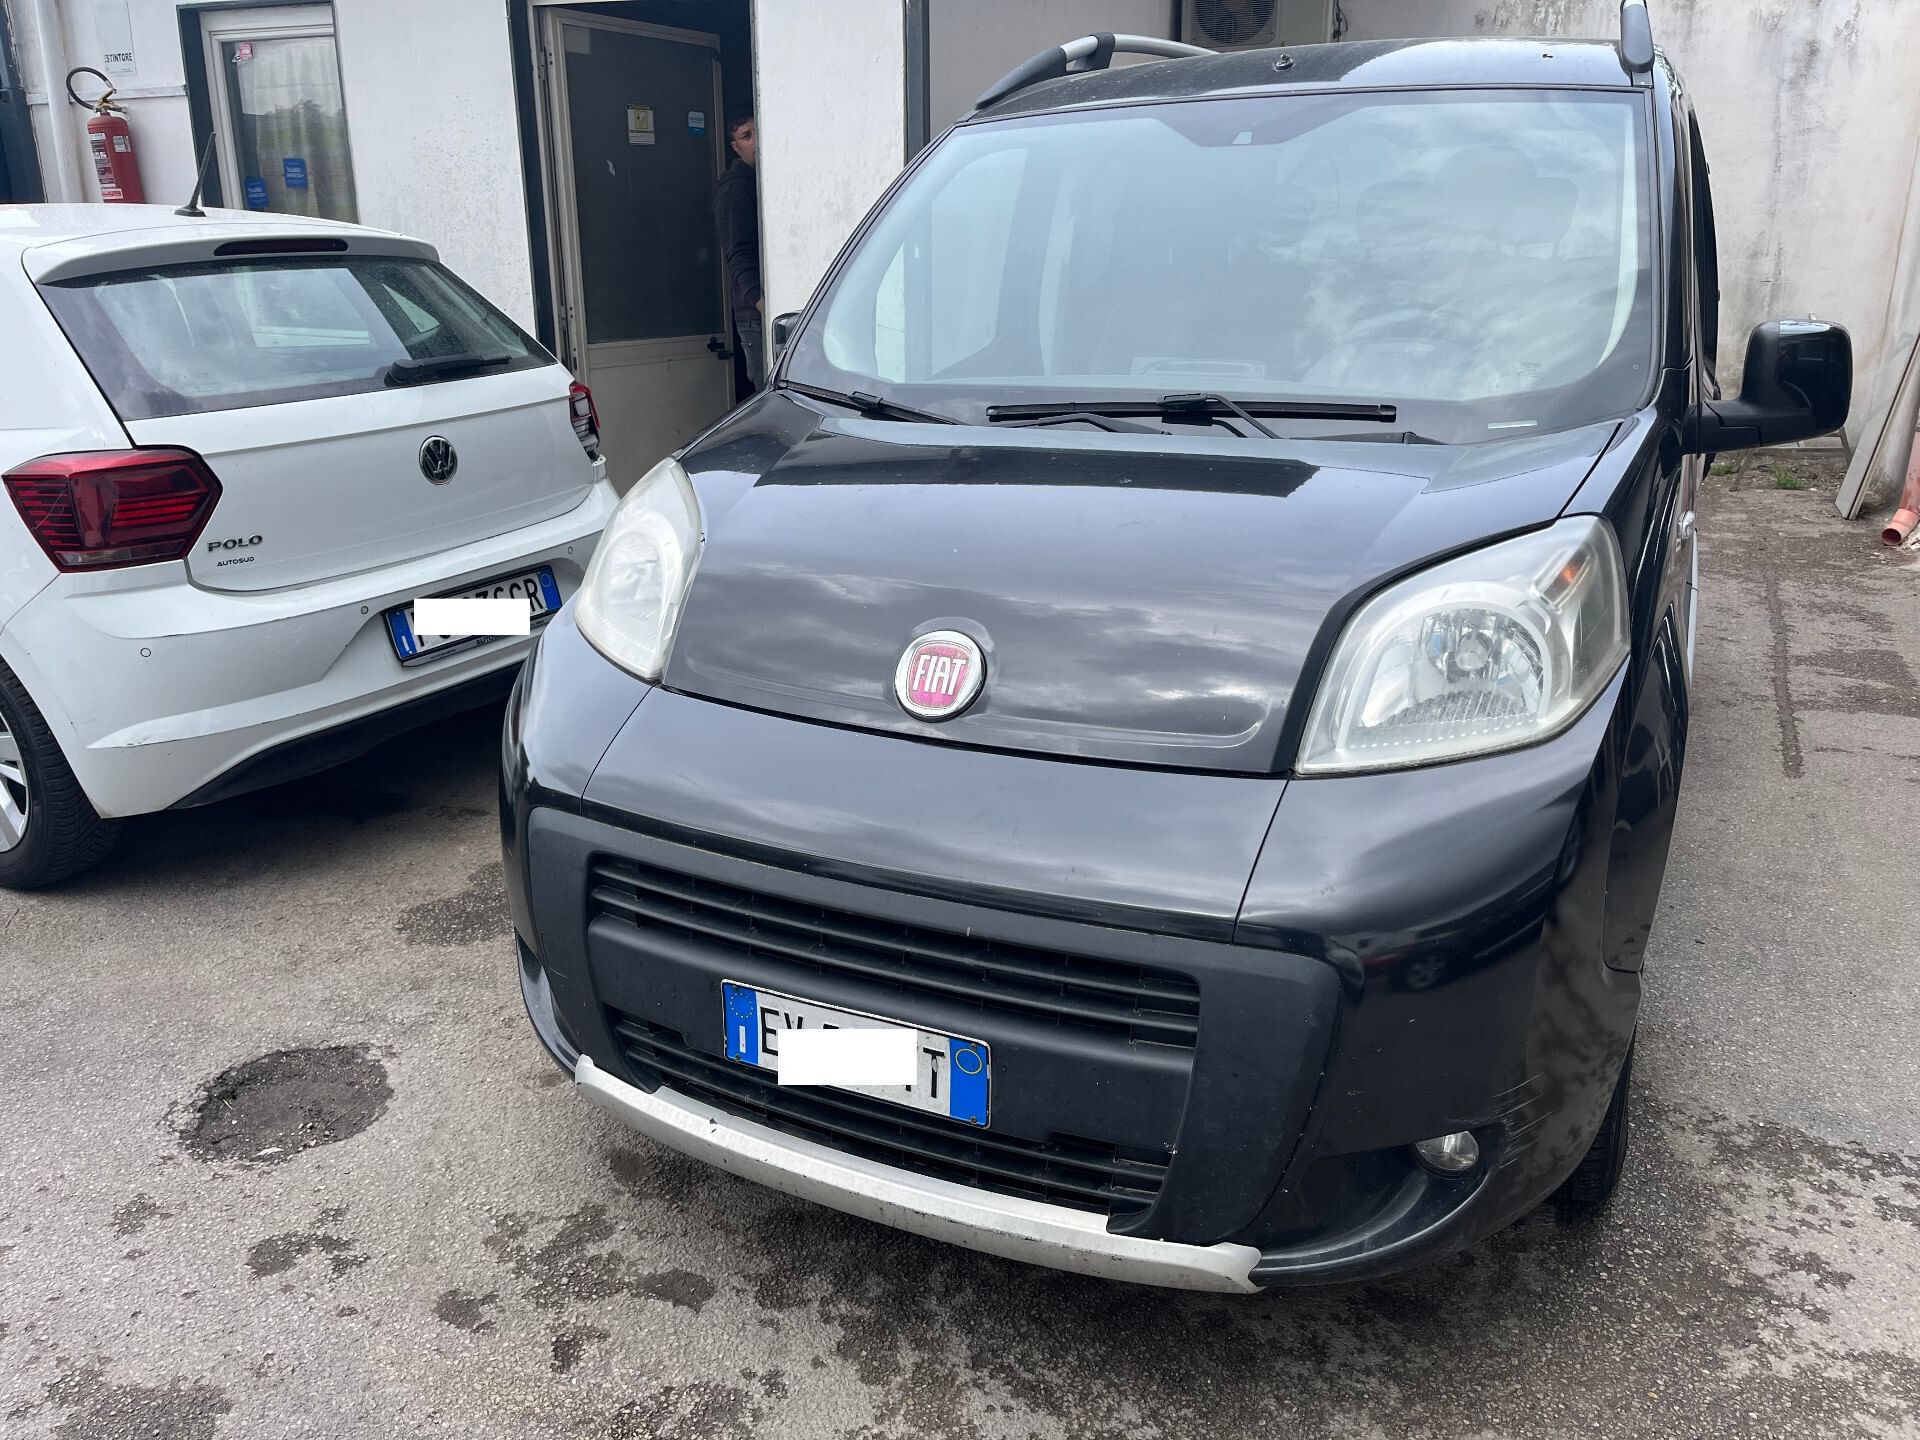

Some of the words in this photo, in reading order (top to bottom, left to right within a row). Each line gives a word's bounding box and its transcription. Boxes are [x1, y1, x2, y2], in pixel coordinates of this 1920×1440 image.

[208, 535, 263, 551] POLO
[217, 556, 255, 567] AUTOSUD
[912, 654, 967, 696] FIAT
